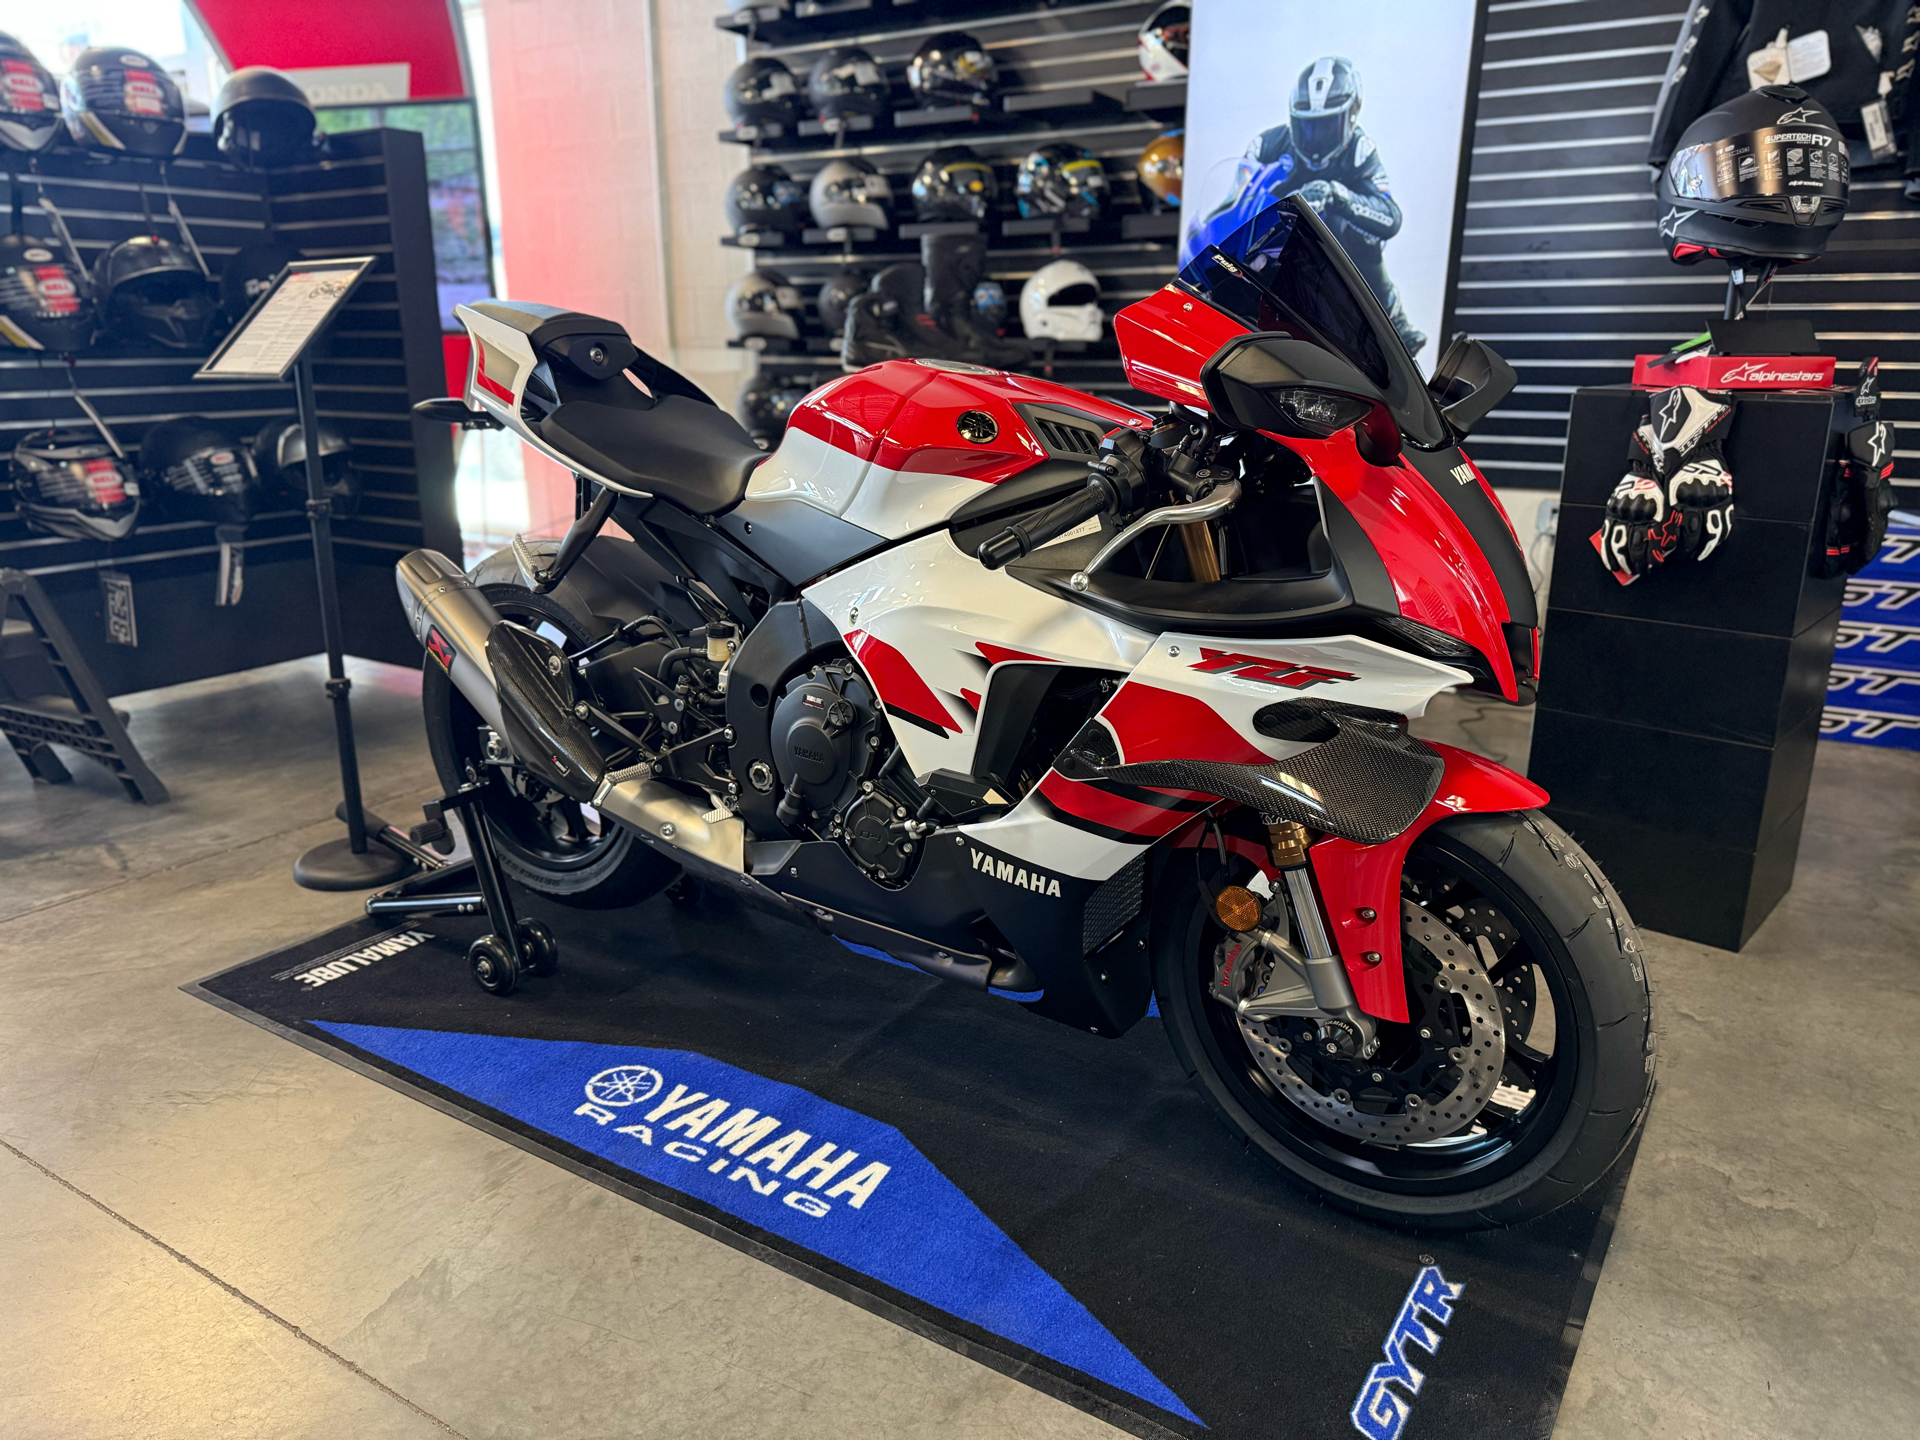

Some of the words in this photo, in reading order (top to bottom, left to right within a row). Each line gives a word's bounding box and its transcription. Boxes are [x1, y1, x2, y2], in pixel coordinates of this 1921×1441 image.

[305, 82, 393, 103] ONDA
[1764, 133, 1811, 144] SUPERTECH
[1812, 133, 1833, 147] R7
[1212, 254, 1238, 273] Puig
[1748, 370, 1825, 384] alpinestars
[794, 745, 826, 765] YAMAHA
[969, 847, 1062, 898] YAMAHA
[293, 930, 436, 988] YAMALUBE
[1220, 943, 1243, 988] brembo
[573, 1101, 832, 1218] RACING
[643, 1083, 892, 1210] YAMAHA
[1350, 1264, 1467, 1441] GYTR
